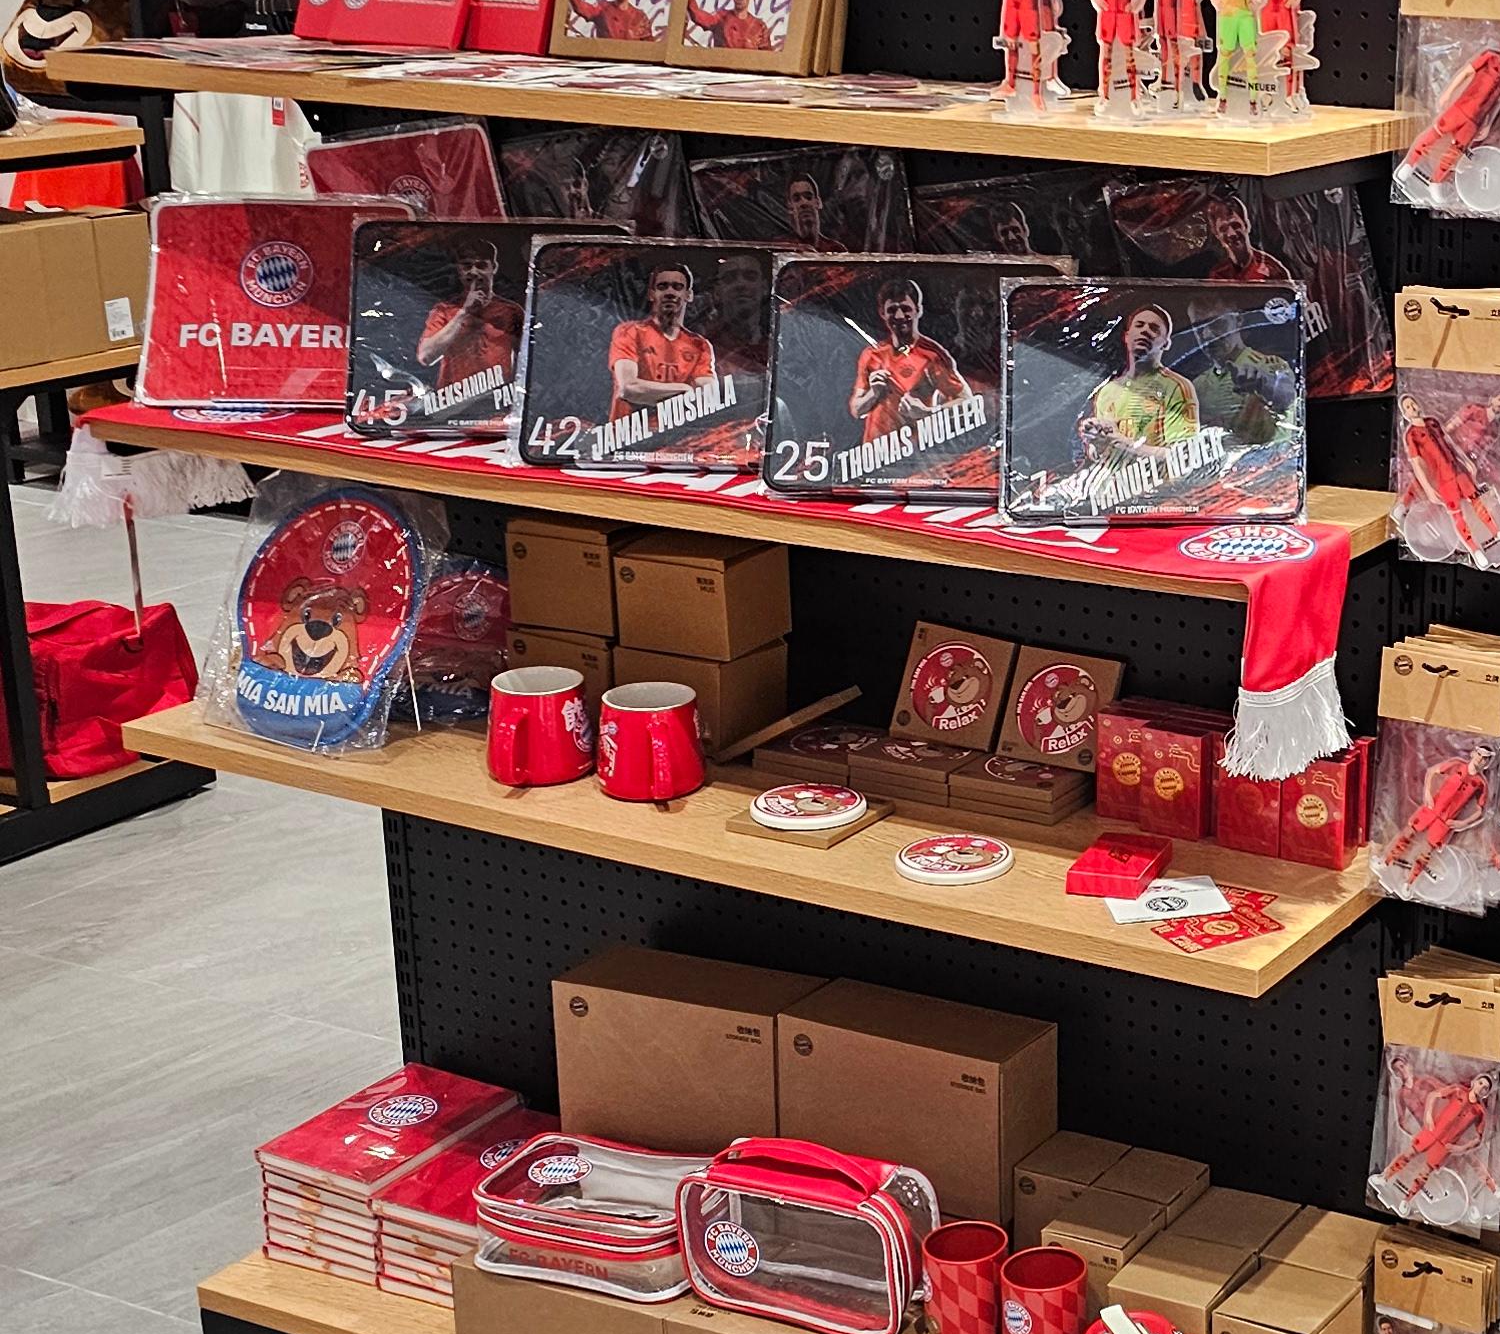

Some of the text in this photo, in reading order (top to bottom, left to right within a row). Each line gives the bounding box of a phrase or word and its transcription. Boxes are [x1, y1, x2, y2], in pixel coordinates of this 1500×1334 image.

[1248, 83, 1277, 93] NEUER
[246, 243, 309, 270] FC BAYERN
[245, 277, 309, 307] MÜNCHEN
[178, 323, 222, 348] FC
[422, 364, 506, 417] ALEKSANDAR
[352, 388, 409, 426] 45
[590, 373, 738, 462] JAMAL MUSIALA
[527, 415, 582, 458] 42
[836, 393, 988, 483] THOMAS MÜLLER
[773, 439, 831, 482] 25
[1089, 456, 1165, 517] MANUEL
[236, 669, 348, 717] MIA SAN MIA
[938, 709, 979, 731] Relax
[1047, 728, 1089, 752] Relax
[706, 1221, 756, 1250] FC BAYERN
[508, 1248, 608, 1279] FC BAYERN
[709, 1248, 757, 1275] MÜNCHEN
